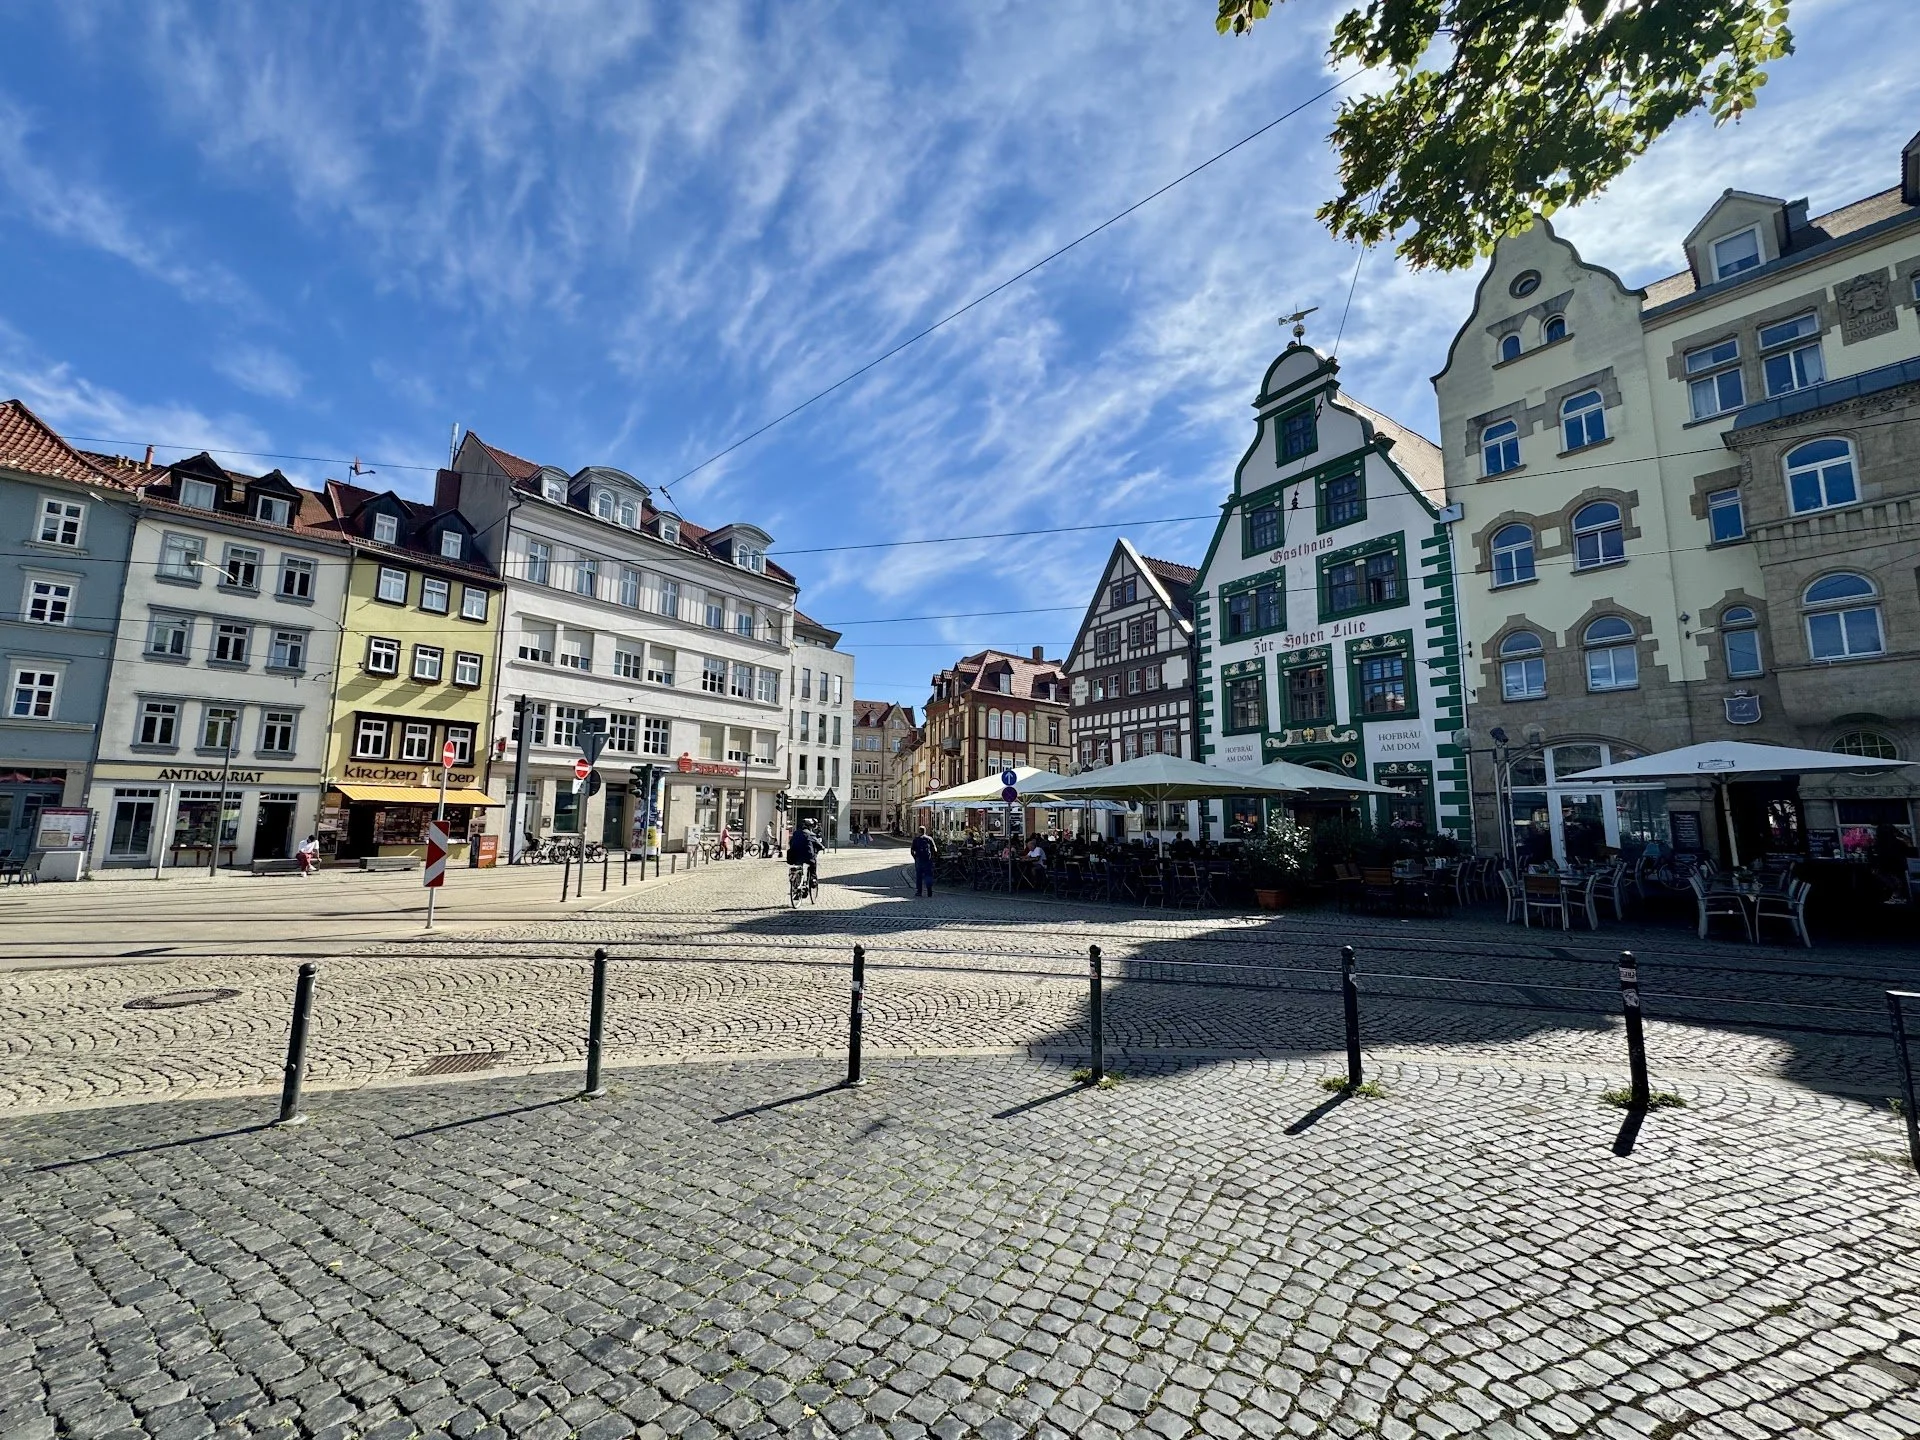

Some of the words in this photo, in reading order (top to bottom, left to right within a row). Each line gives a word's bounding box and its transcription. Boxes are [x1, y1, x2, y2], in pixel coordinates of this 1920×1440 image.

[1269, 536, 1334, 564] Gasthaus
[1253, 640, 1274, 656] Zur
[1282, 630, 1324, 649] Hohen
[1331, 621, 1366, 638] Lilie
[1378, 730, 1421, 741] HOFBRÄU
[1380, 743, 1395, 752] AM
[1397, 741, 1420, 751] DOM
[1226, 755, 1236, 763] AM
[1237, 754, 1253, 762] DOM
[157, 768, 264, 783] ANTIQUARIAT
